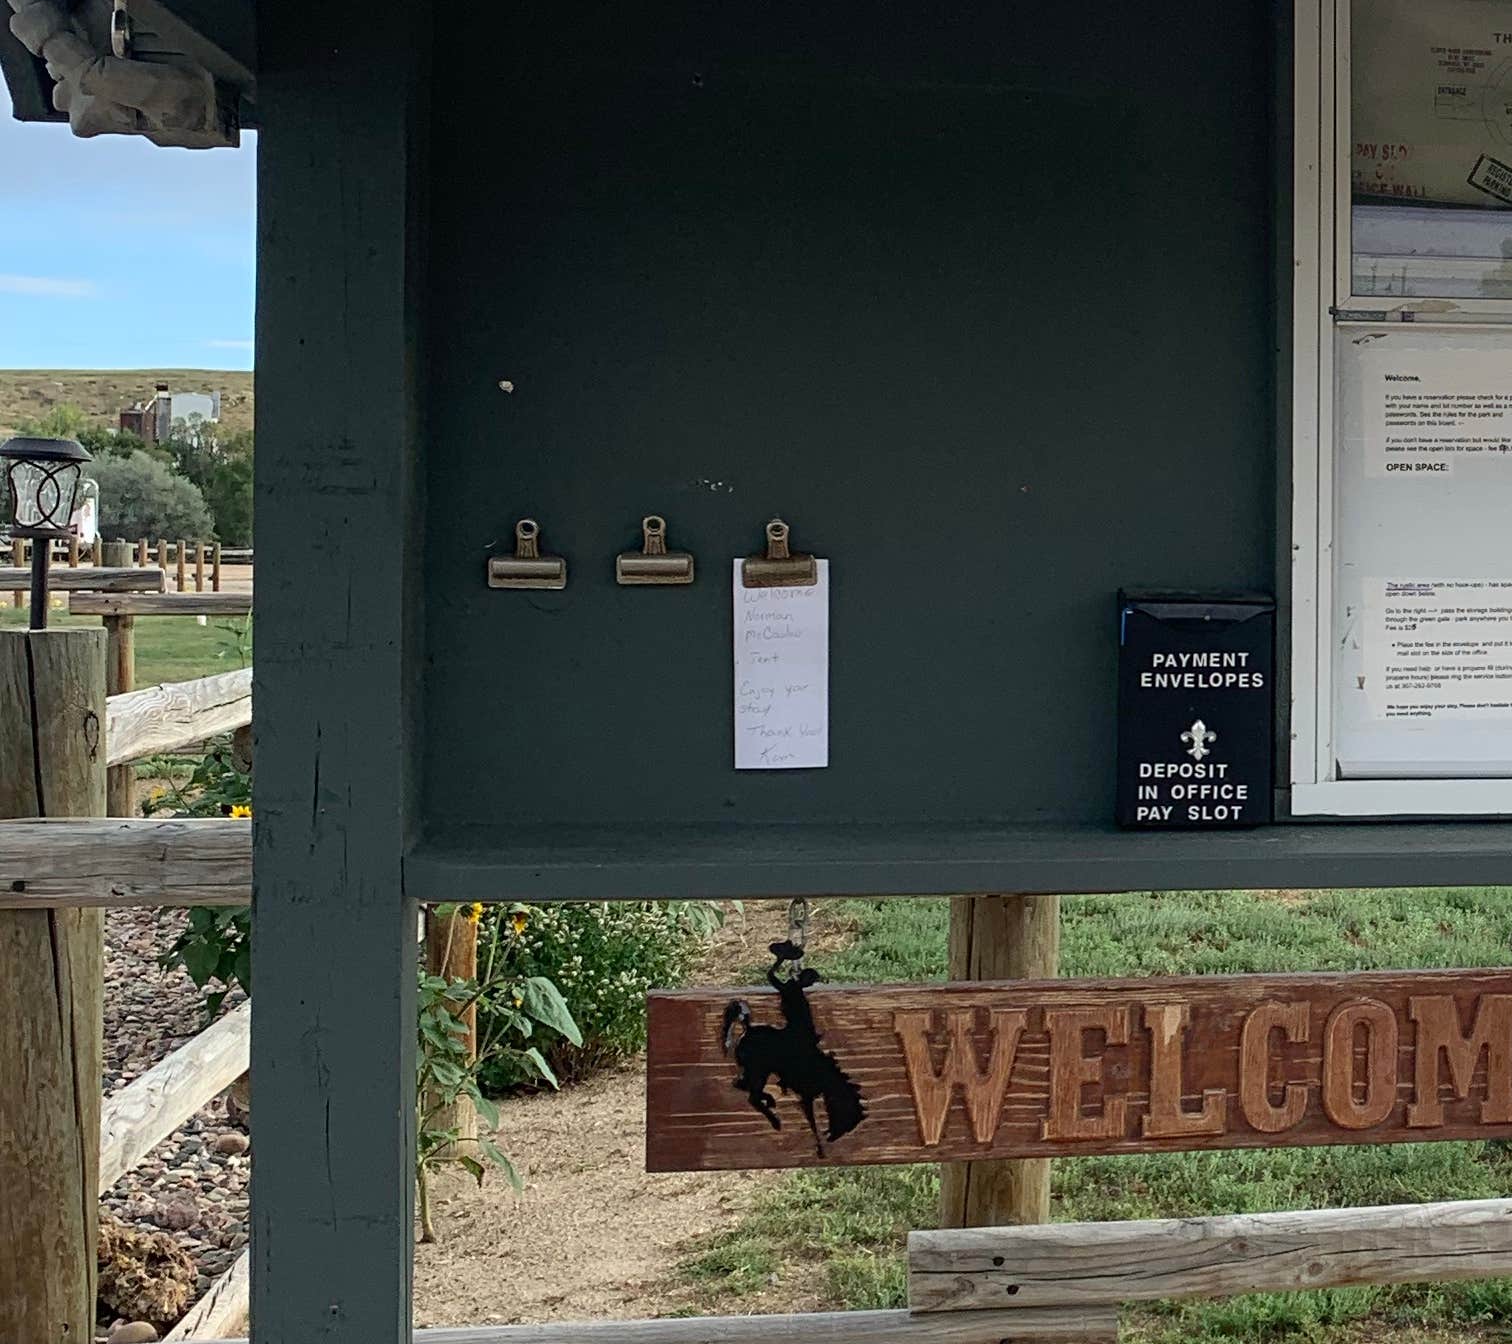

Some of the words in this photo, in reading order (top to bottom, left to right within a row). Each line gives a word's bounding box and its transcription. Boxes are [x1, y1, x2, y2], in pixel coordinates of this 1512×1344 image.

[1385, 463, 1413, 472] OPEN
[1414, 462, 1450, 472] SPACE:
[1152, 652, 1250, 668] PAYMENT
[1140, 672, 1265, 688] ENVELOPES
[1139, 763, 1229, 779] DEPOSIT
[1137, 785, 1159, 800] IN
[1170, 784, 1249, 800] OFFICE
[1136, 806, 1174, 821] PAY
[1187, 805, 1244, 821] SLOT
